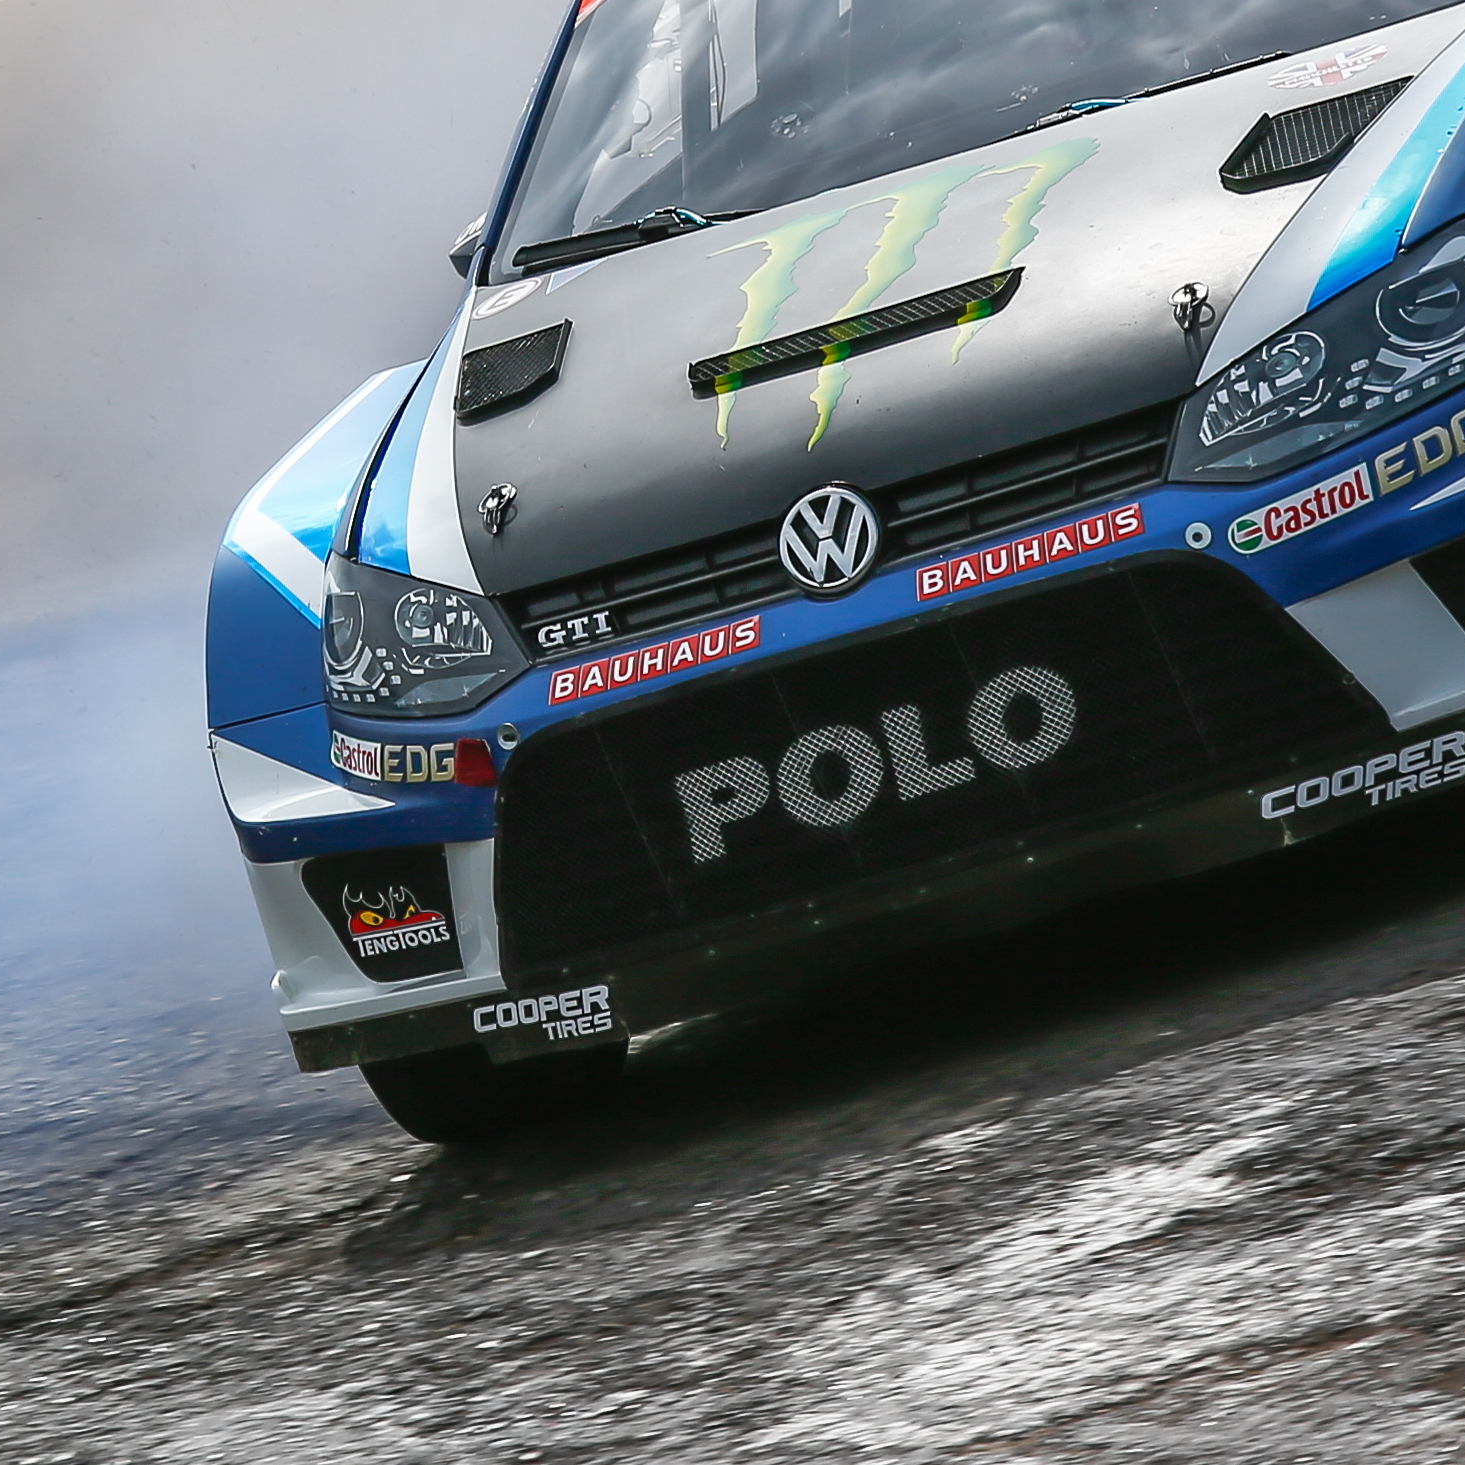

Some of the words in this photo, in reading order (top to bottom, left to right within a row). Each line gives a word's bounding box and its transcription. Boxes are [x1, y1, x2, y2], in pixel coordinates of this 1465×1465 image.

[1264, 470, 1369, 542] Castrol
[920, 505, 1143, 598] BAUHAUS
[538, 611, 613, 648] GTI
[553, 618, 760, 701] BAUHAUS
[340, 736, 379, 778] Castrol
[674, 666, 1077, 865] POLO
[473, 985, 611, 1034] COOPER
[542, 1013, 612, 1040] TIRES
